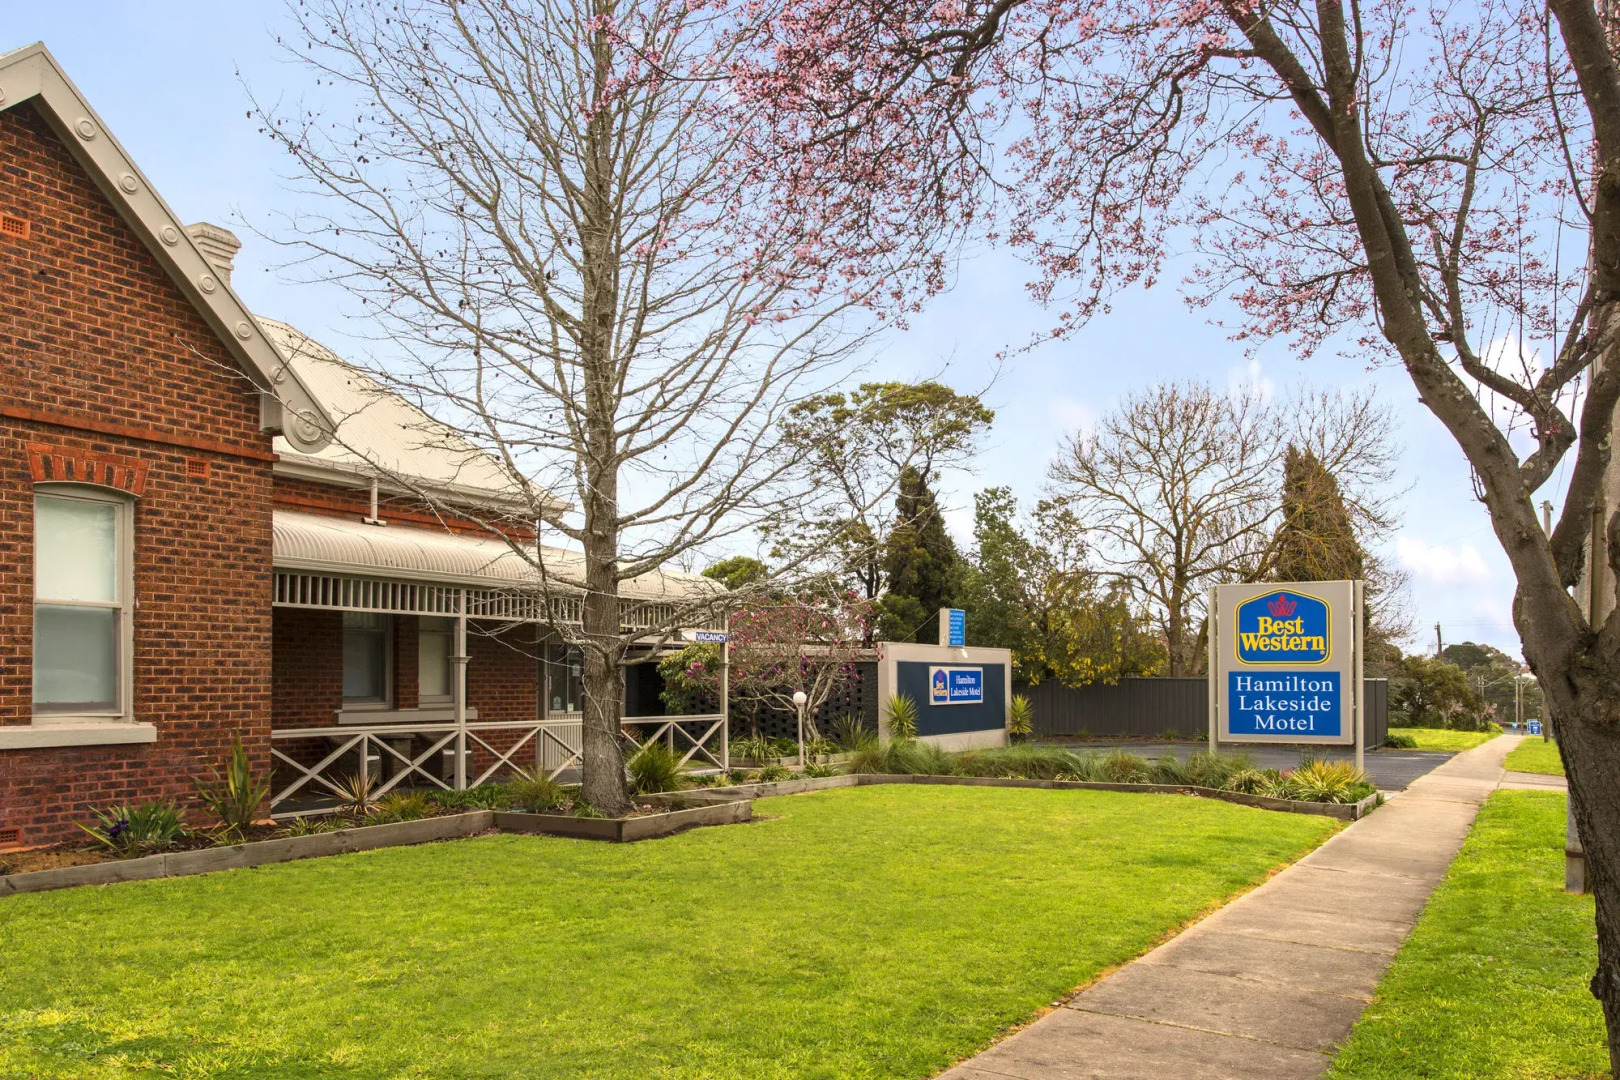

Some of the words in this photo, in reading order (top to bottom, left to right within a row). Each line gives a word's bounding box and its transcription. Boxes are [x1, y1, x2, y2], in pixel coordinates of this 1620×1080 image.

[1257, 616, 1304, 635] Best
[696, 633, 727, 642] VACANCY
[1240, 632, 1326, 651] Western
[1235, 676, 1334, 692] Hamilton
[1238, 695, 1331, 711] Lakeside
[1254, 714, 1315, 731] Motel
